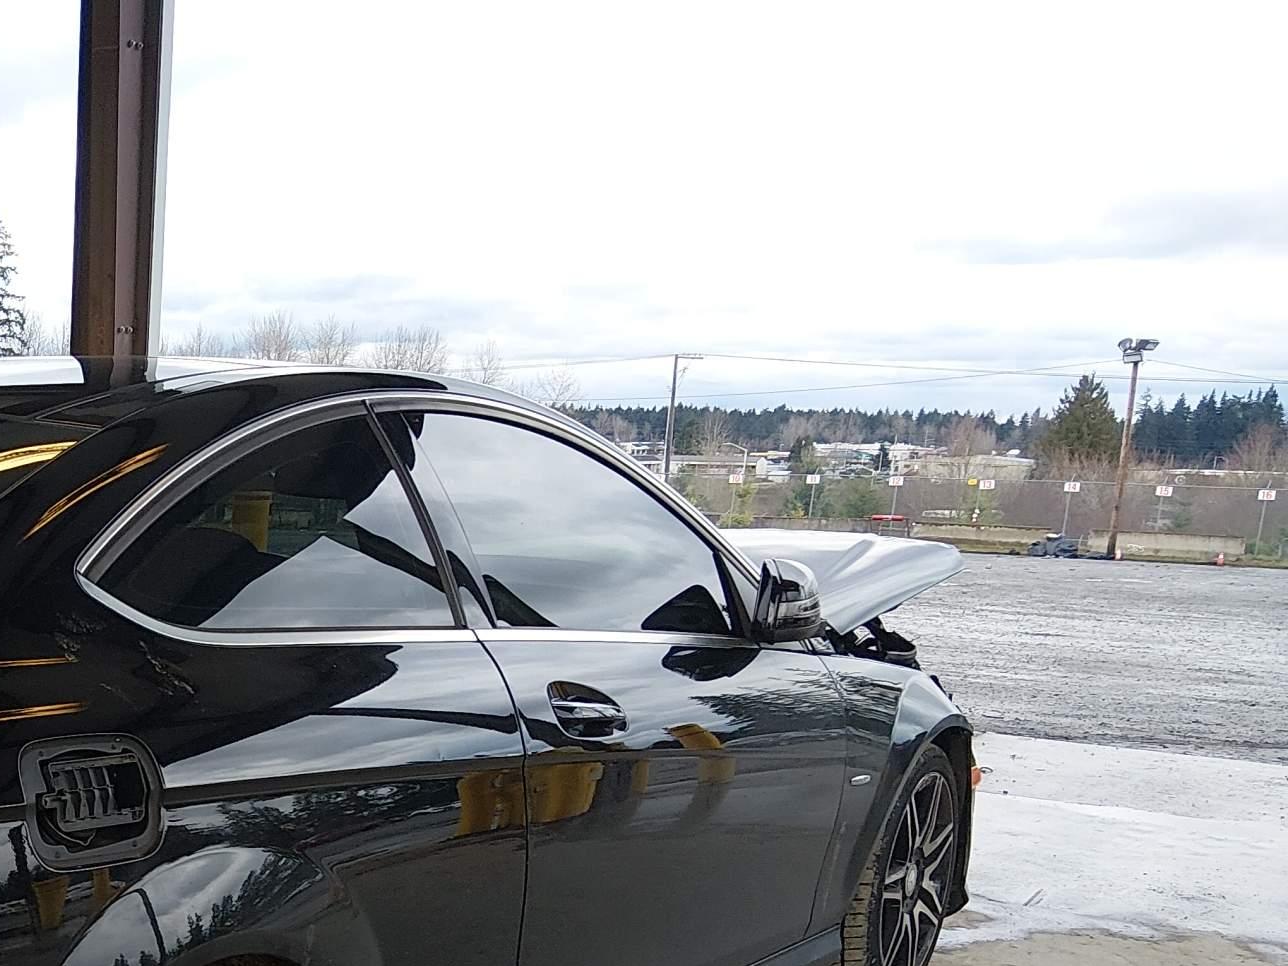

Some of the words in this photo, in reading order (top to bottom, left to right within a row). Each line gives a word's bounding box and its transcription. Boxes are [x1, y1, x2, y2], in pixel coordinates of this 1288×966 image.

[983, 481, 992, 489] 13
[1067, 483, 1077, 491] 14
[1159, 487, 1170, 496] 15
[1262, 491, 1273, 500] 16
